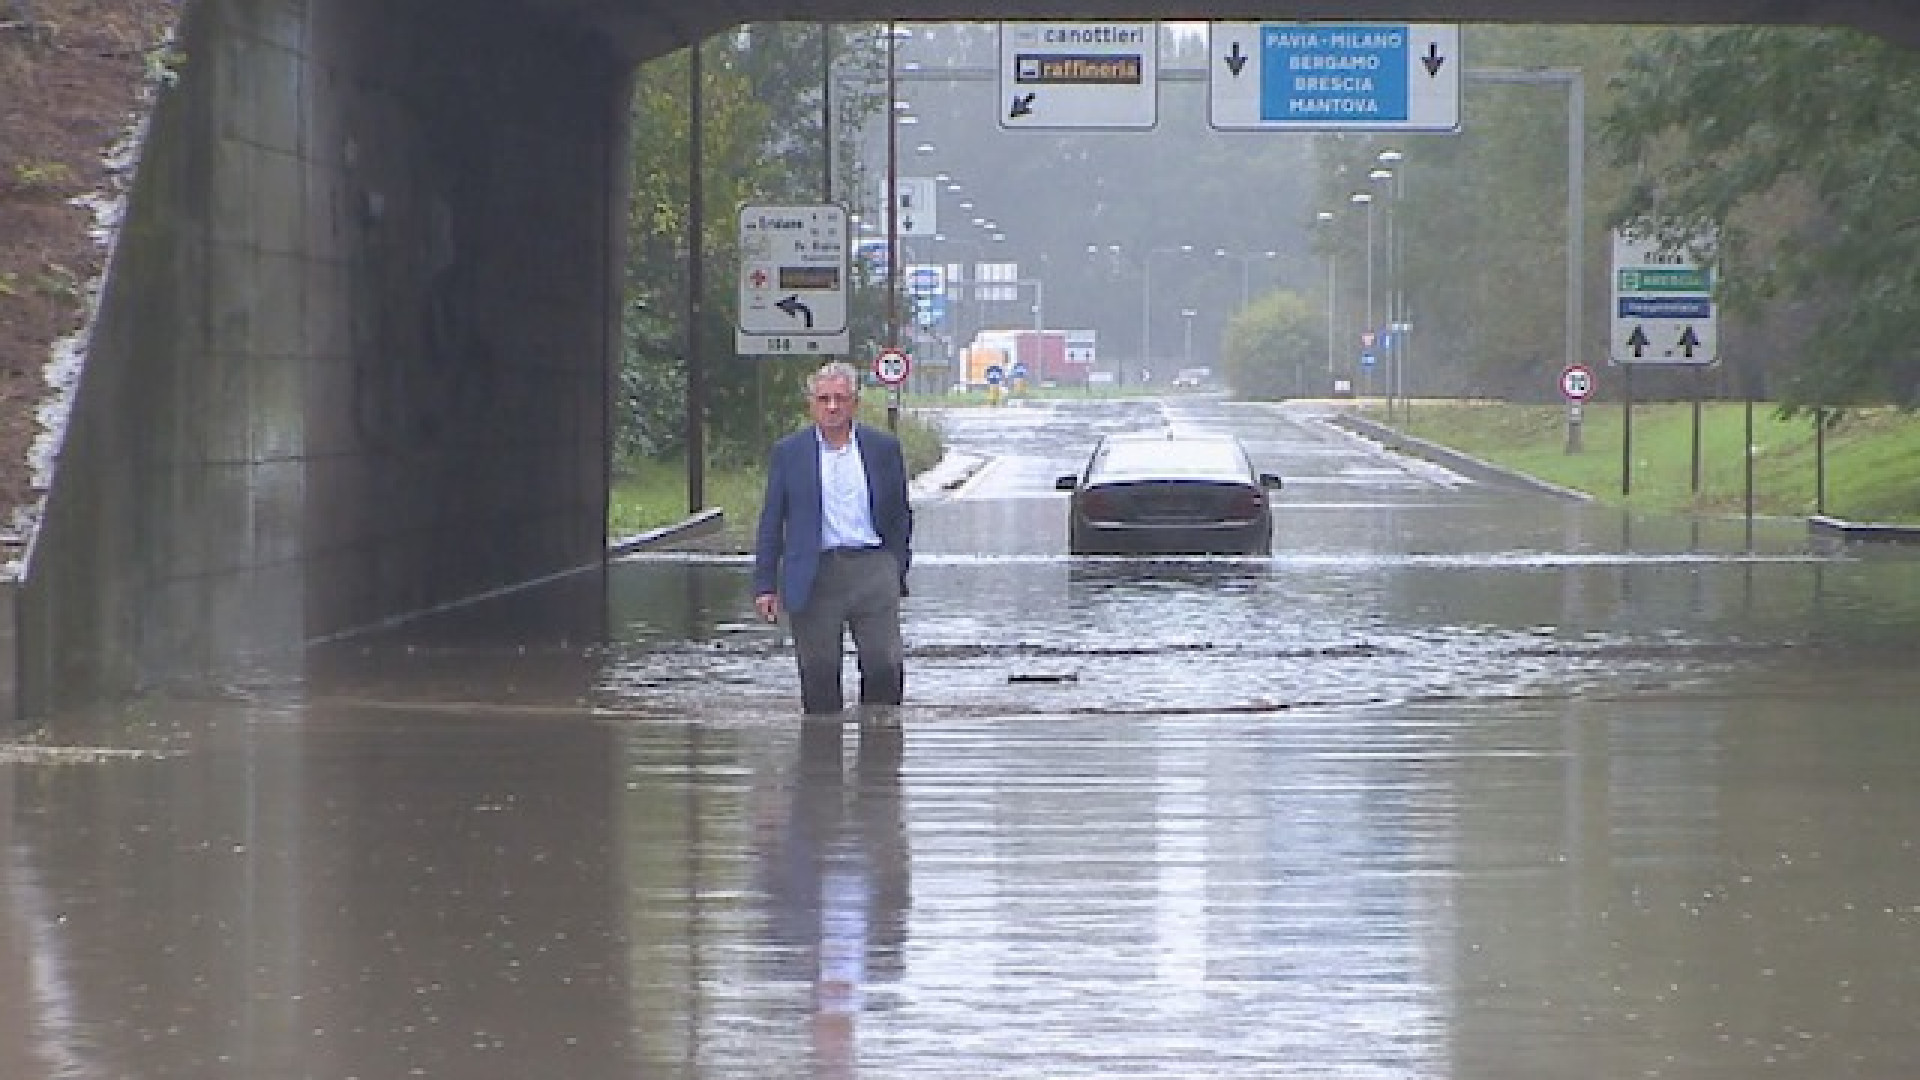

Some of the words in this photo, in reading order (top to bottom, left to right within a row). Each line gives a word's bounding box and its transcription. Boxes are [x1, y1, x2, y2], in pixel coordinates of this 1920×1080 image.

[1043, 25, 1144, 43] canottieri
[1043, 59, 1138, 77] raffineria
[1289, 54, 1381, 71] BERGAMO
[1294, 75, 1374, 93] BRESCIA
[1289, 97, 1379, 114] MANTOVA
[881, 359, 903, 376] 70
[1568, 374, 1588, 391] 70
